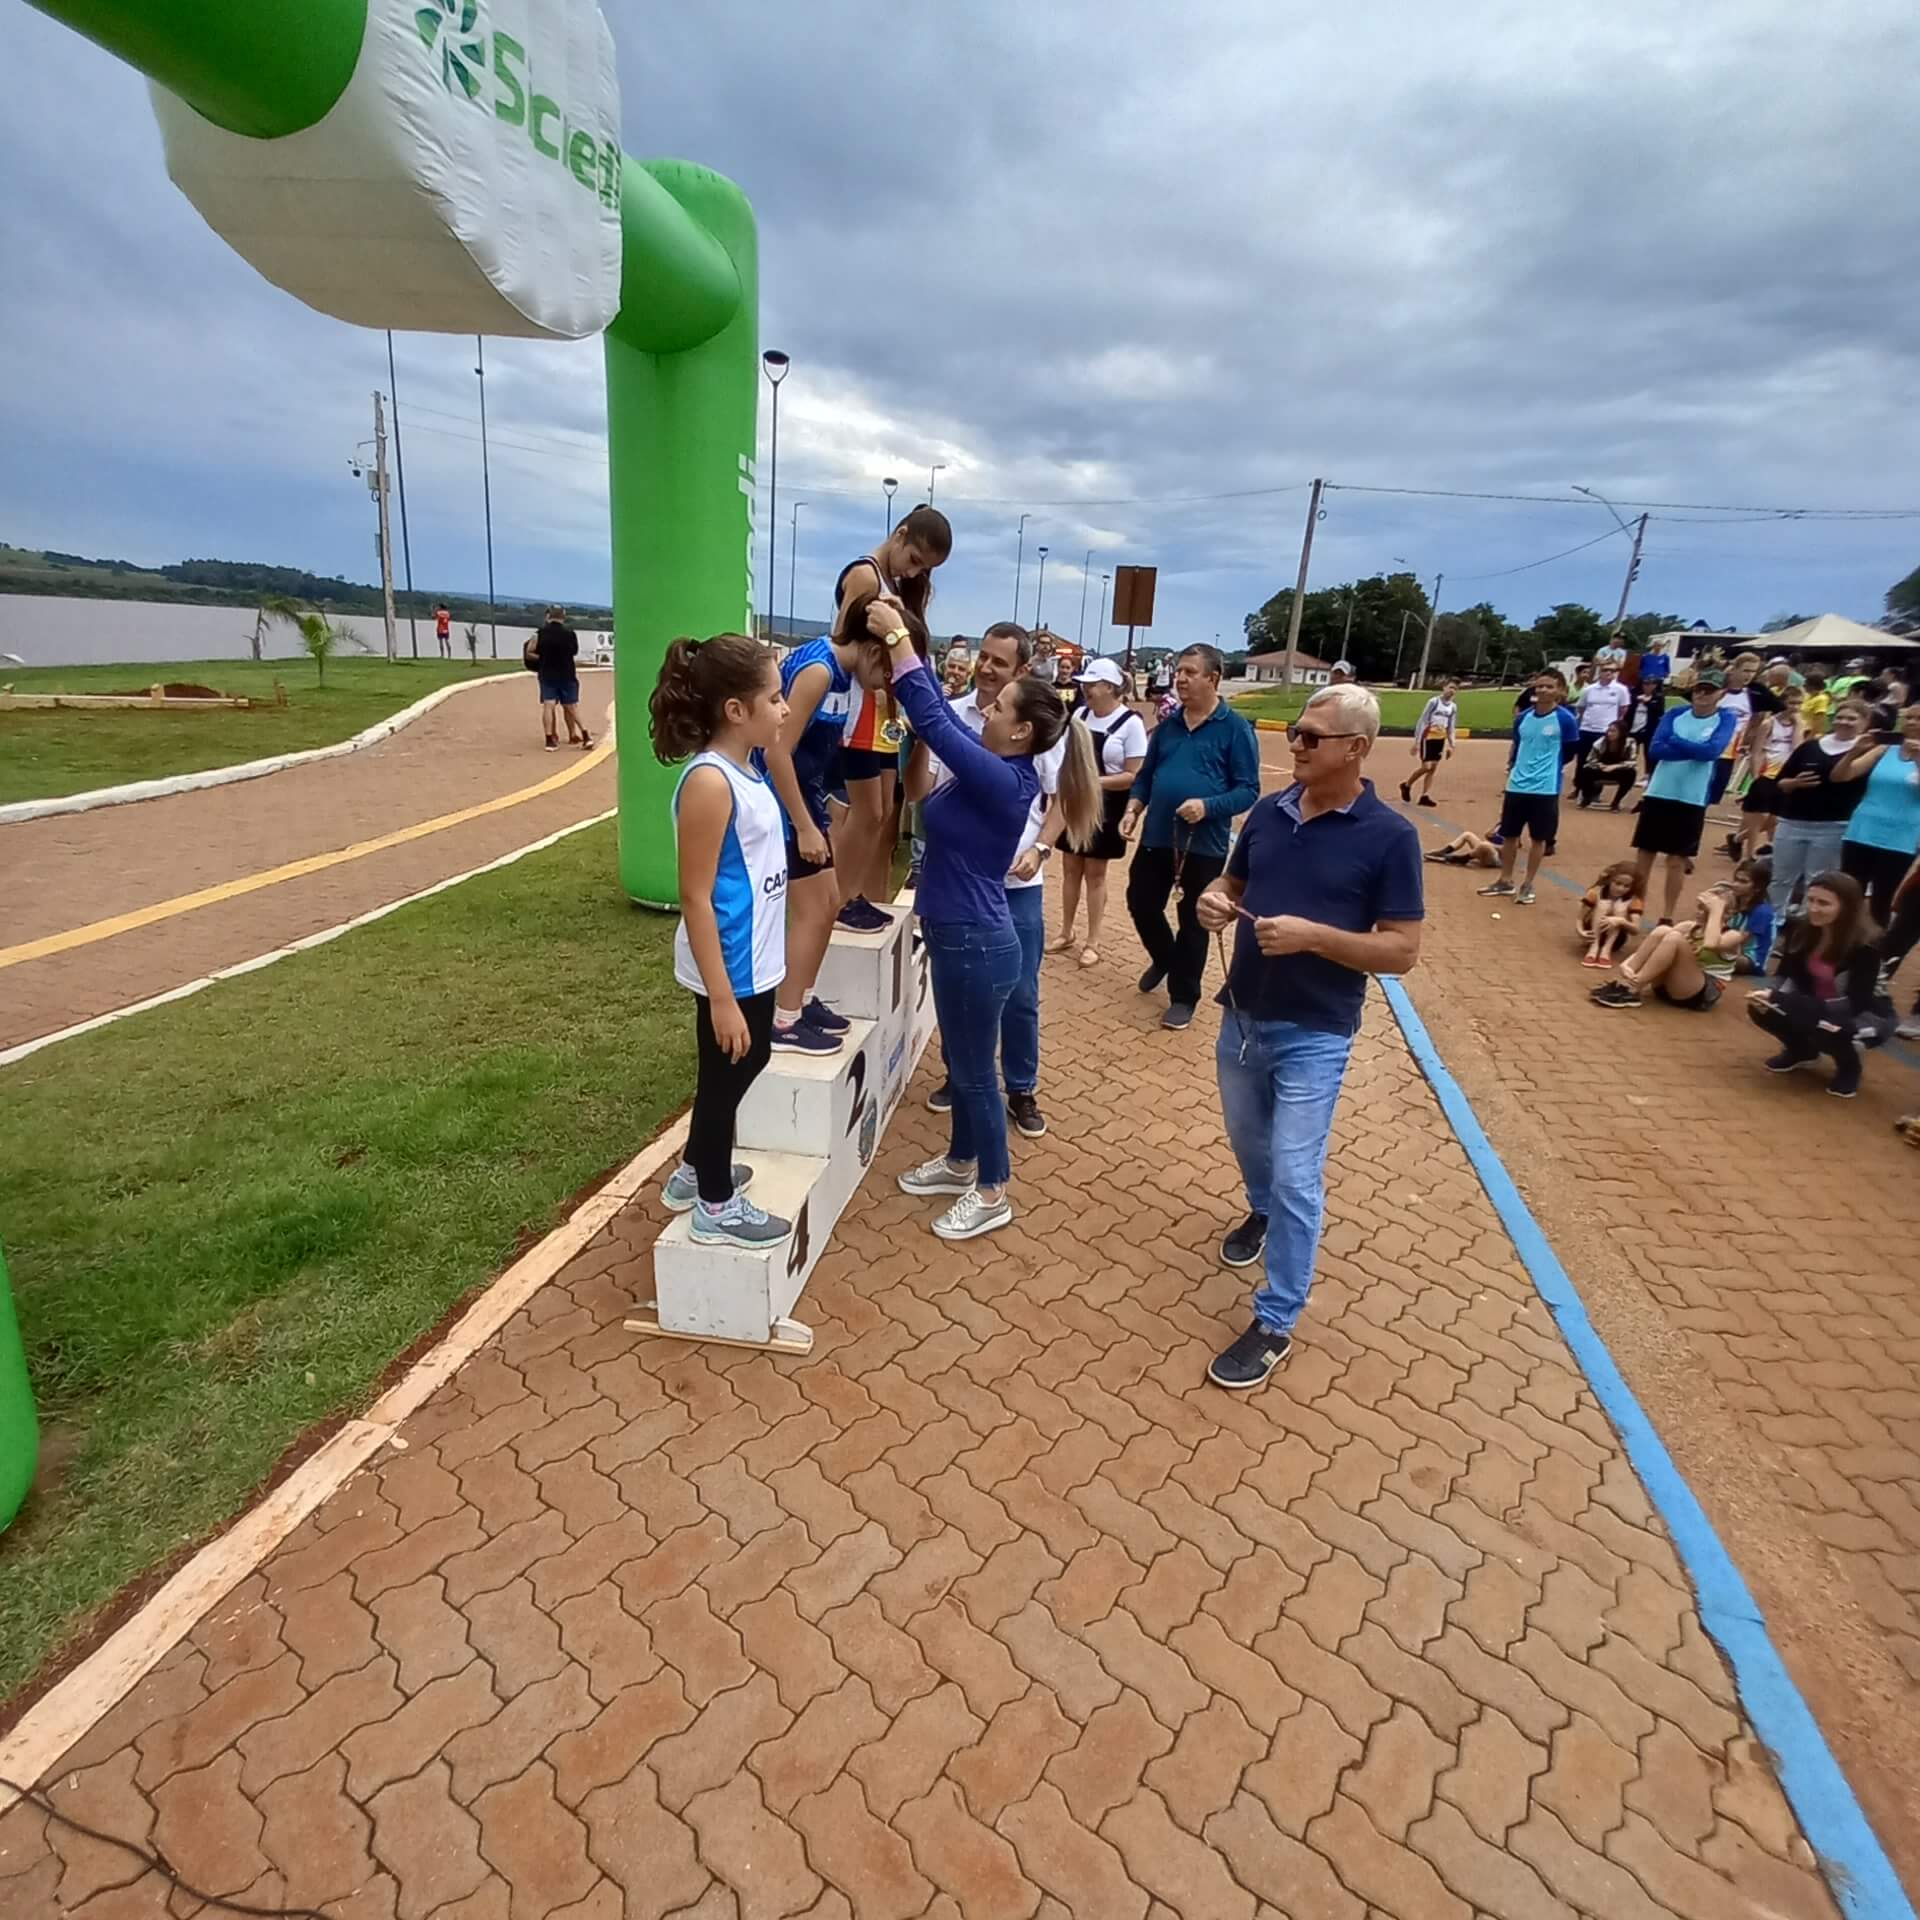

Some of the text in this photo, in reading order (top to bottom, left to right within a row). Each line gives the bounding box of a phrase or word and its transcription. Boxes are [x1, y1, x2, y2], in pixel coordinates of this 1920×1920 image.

[891, 924, 902, 1013] 1
[845, 1049, 868, 1139] 2
[787, 1193, 809, 1278] 4
